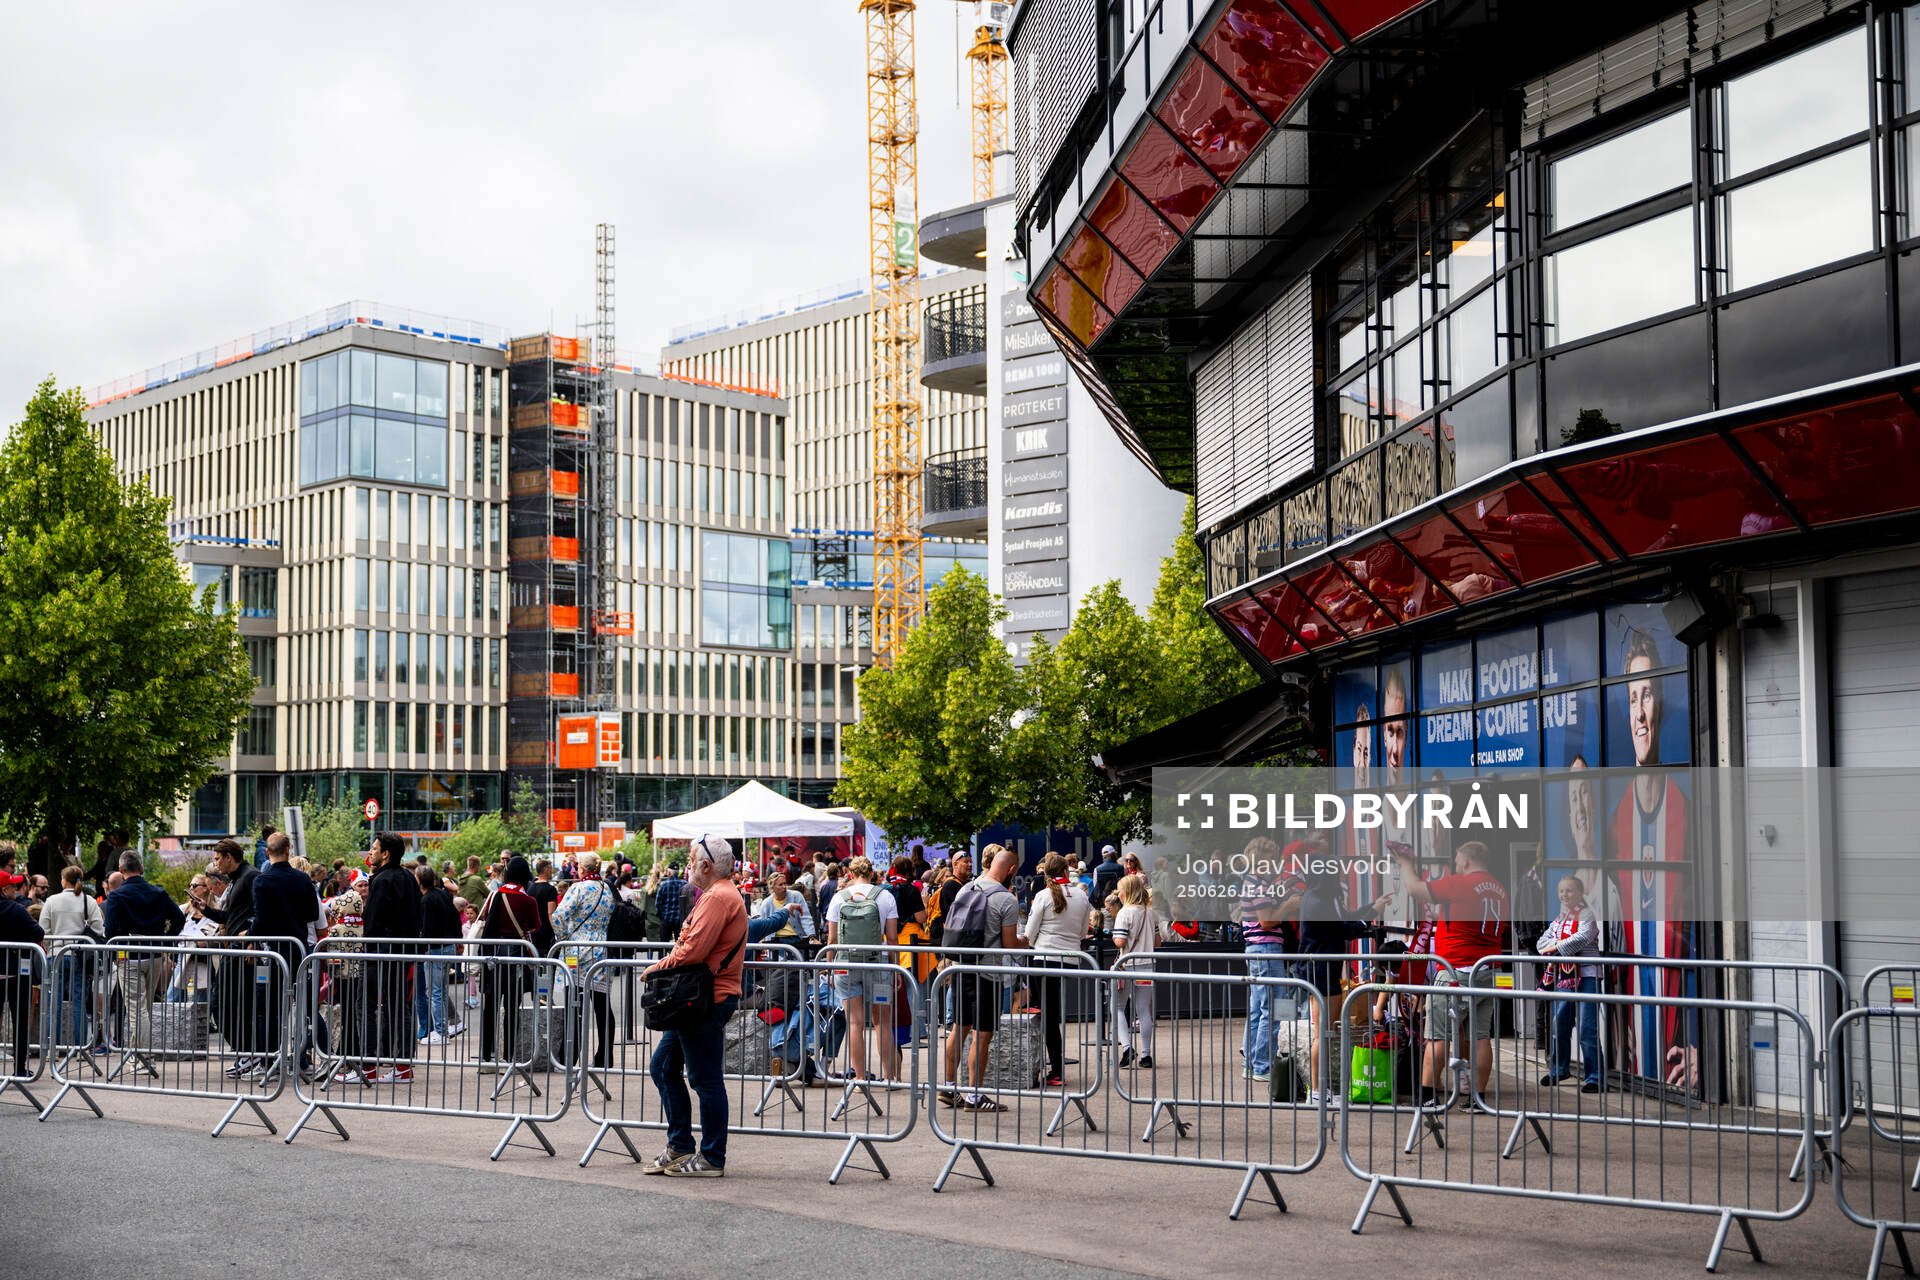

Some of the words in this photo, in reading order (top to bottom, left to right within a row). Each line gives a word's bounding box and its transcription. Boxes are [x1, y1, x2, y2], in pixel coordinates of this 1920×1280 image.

[897, 226, 916, 255] 2
[1005, 367, 1034, 383] REMA
[1036, 362, 1061, 377] 1000
[1003, 397, 1062, 417] PROTEKET
[1005, 501, 1063, 520] Kondis
[1054, 536, 1064, 546] AS
[1480, 648, 1558, 698] FOOTBALL
[1485, 700, 1529, 738] COME
[1471, 751, 1494, 766] OFICIAL
[1495, 749, 1507, 763] FAN
[1507, 747, 1524, 762] SHOP
[367, 804, 377, 815] 40
